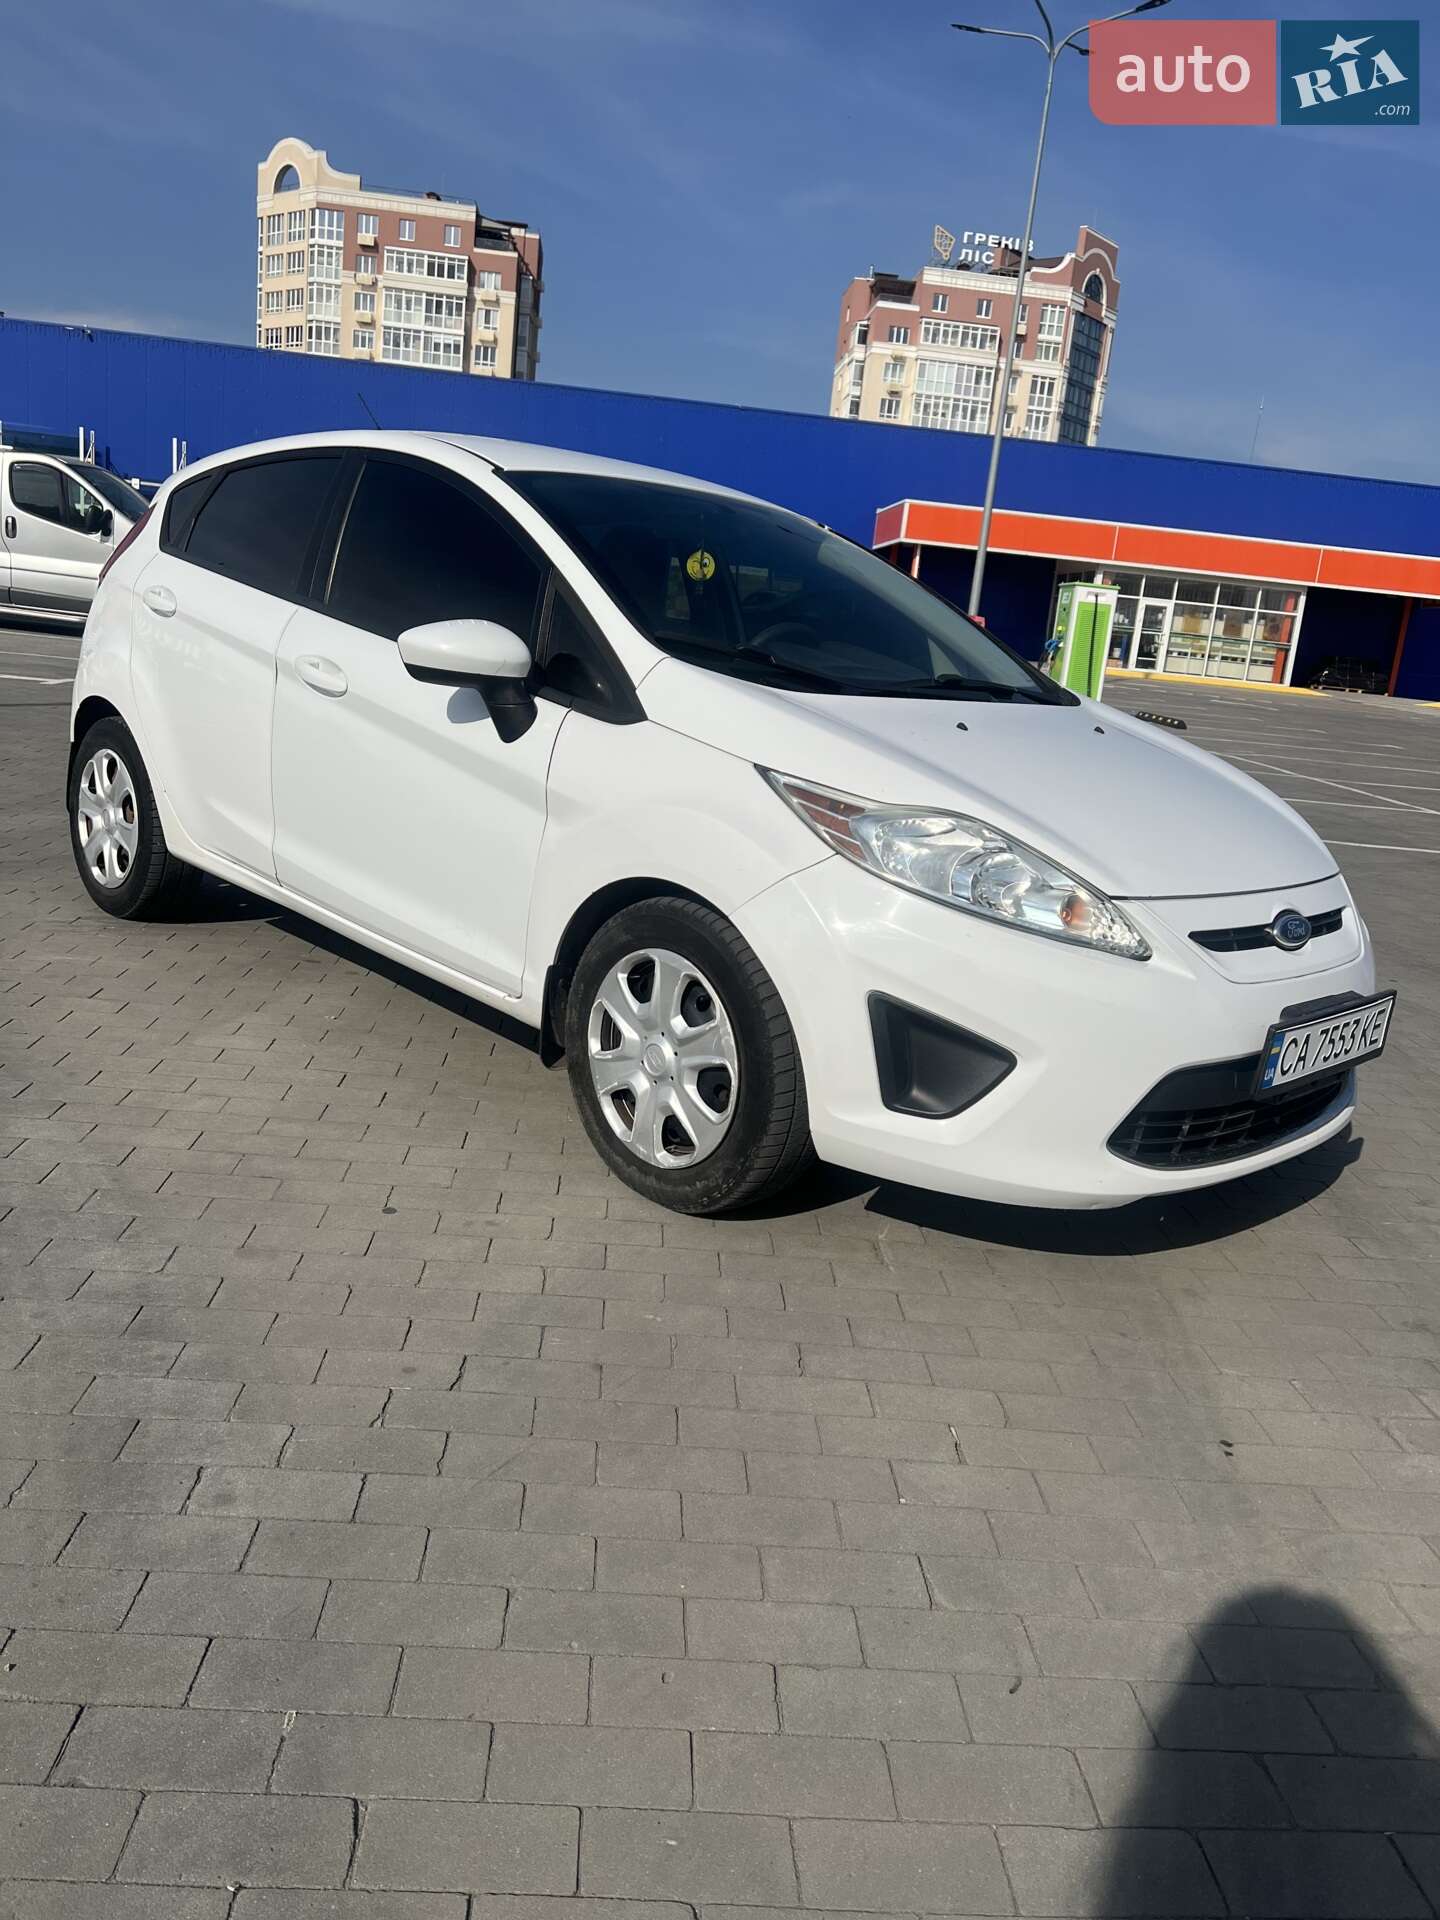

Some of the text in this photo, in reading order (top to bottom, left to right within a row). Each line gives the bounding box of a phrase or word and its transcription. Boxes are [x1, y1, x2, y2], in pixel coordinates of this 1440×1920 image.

[959, 248, 995, 264] ЛІС
[1280, 1007, 1386, 1076] CA 7553 KE
